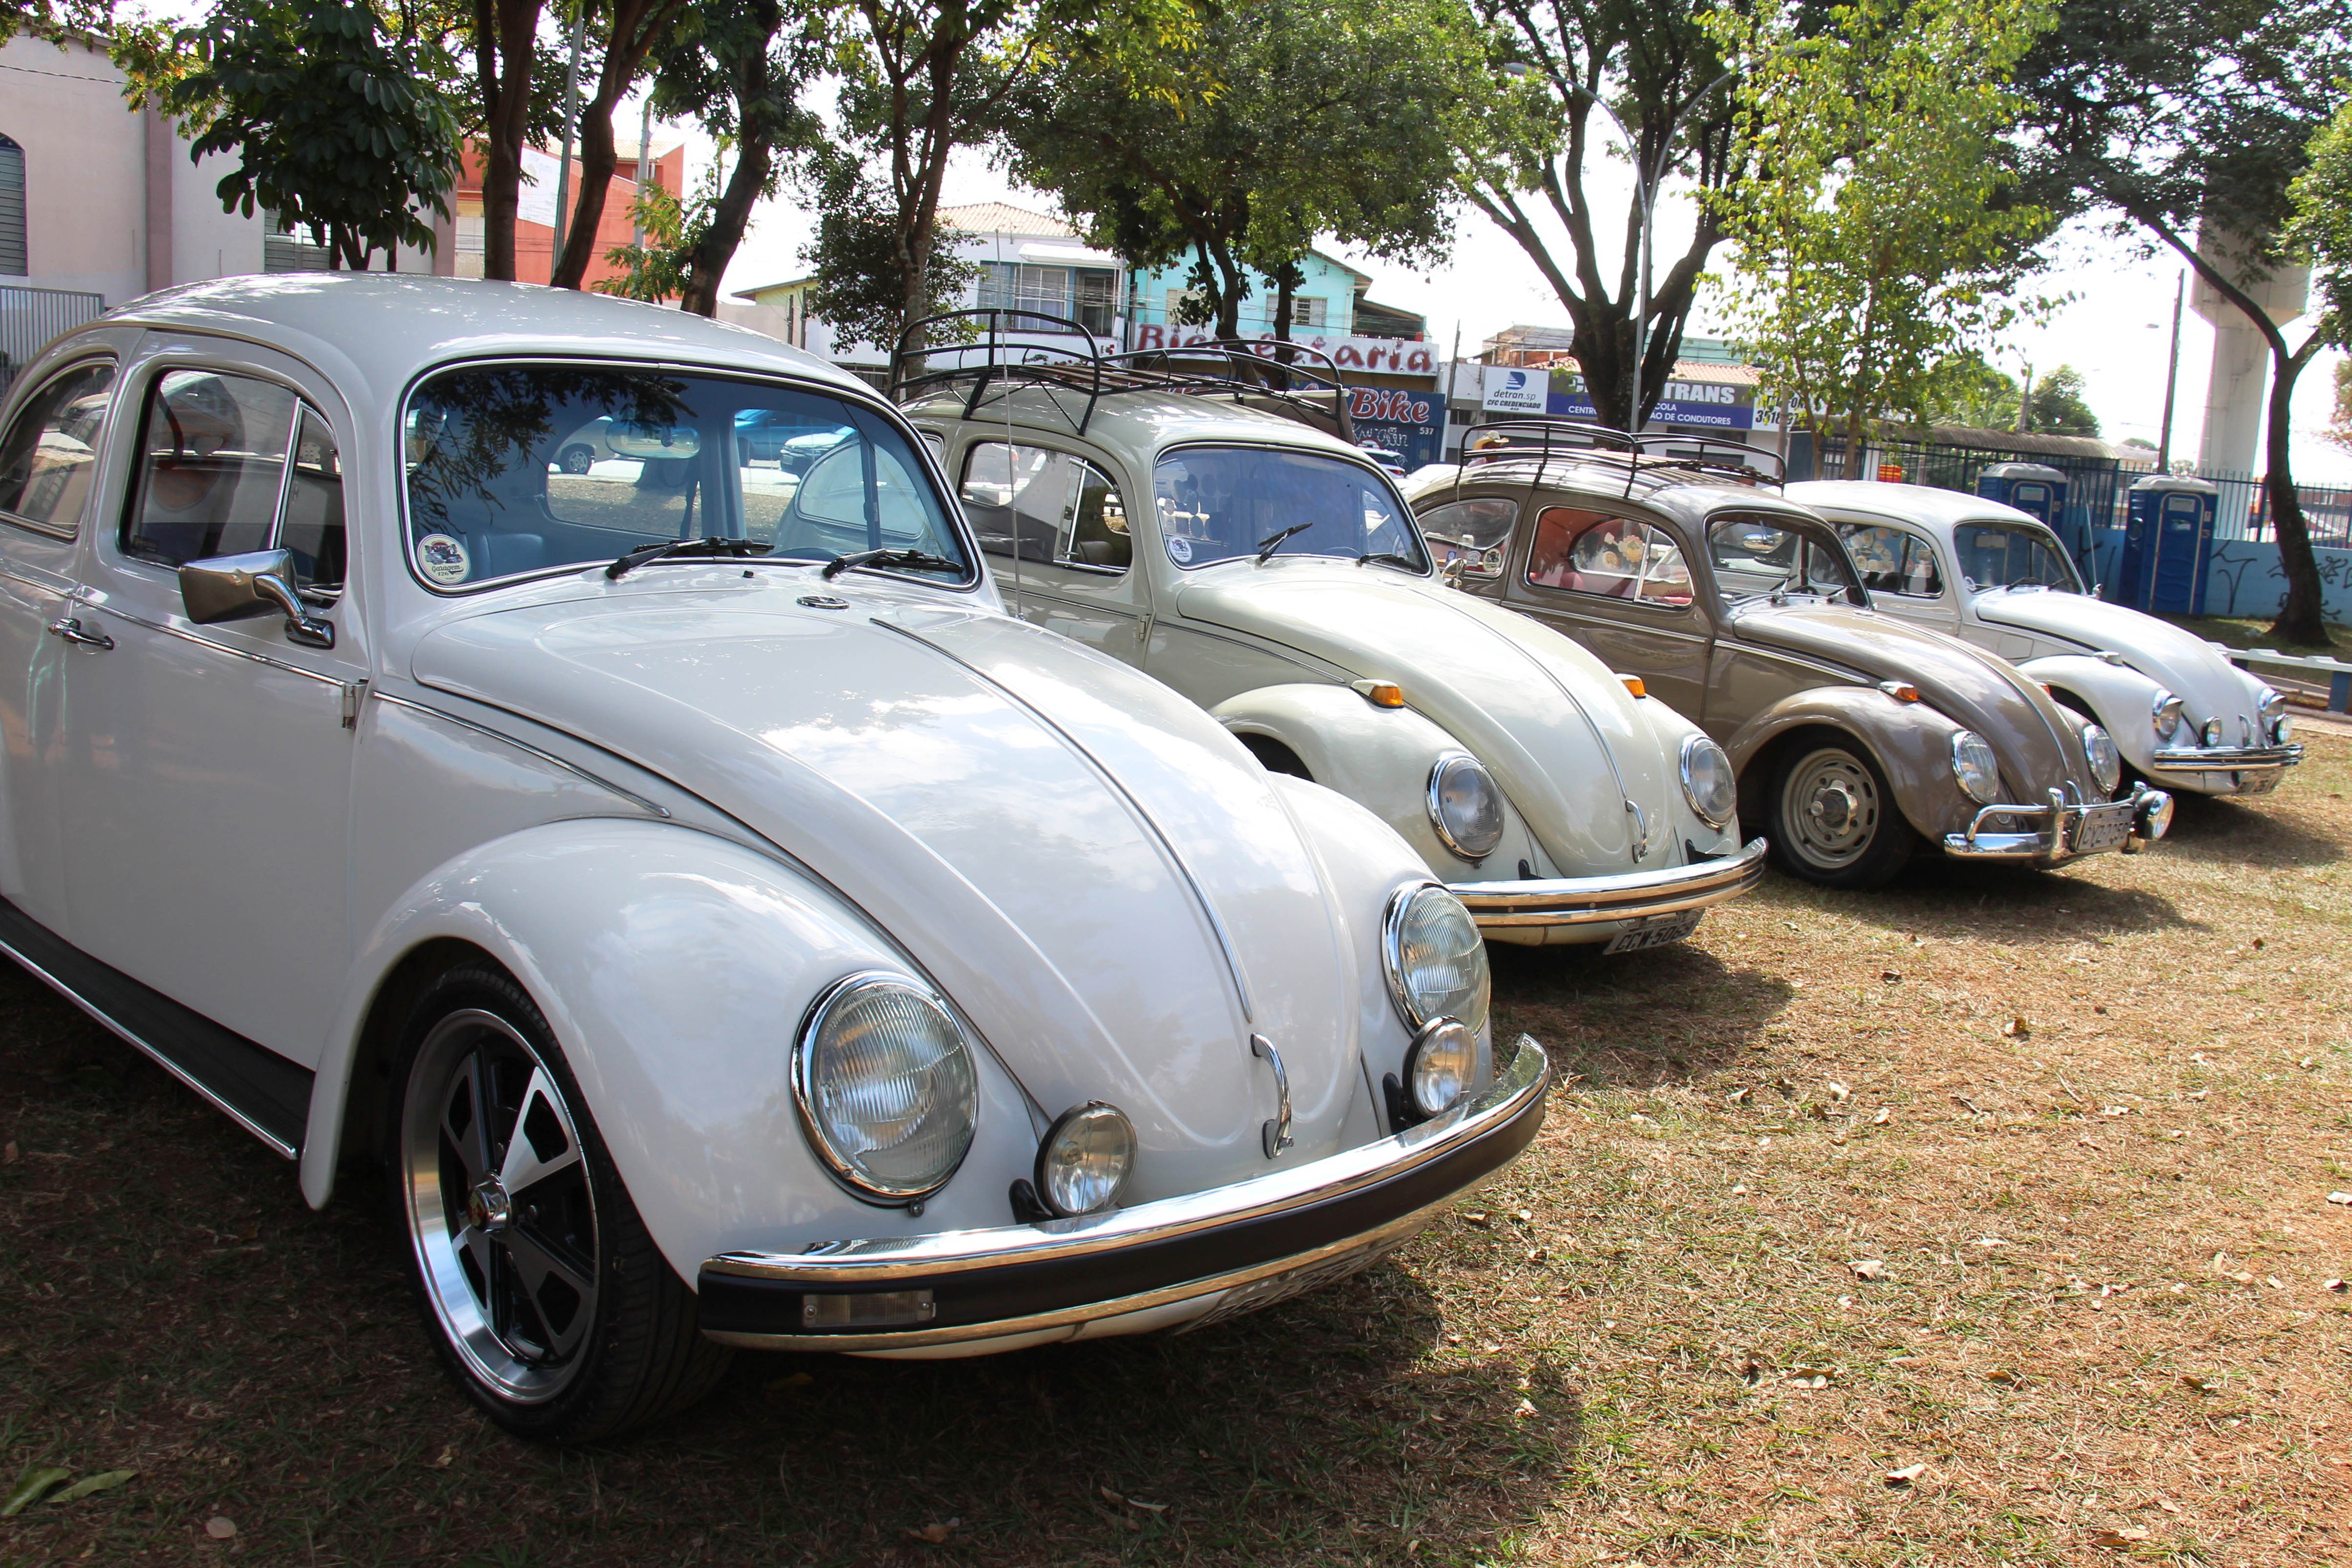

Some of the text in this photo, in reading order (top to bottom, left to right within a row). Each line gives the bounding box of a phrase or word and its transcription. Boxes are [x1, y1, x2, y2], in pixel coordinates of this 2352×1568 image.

[1494, 389, 1536, 401] detran.sp
[1350, 387, 1429, 423] Bike
[1500, 400, 1541, 409] CREDENCIADO
[1677, 414, 1731, 425] CONDUTORES
